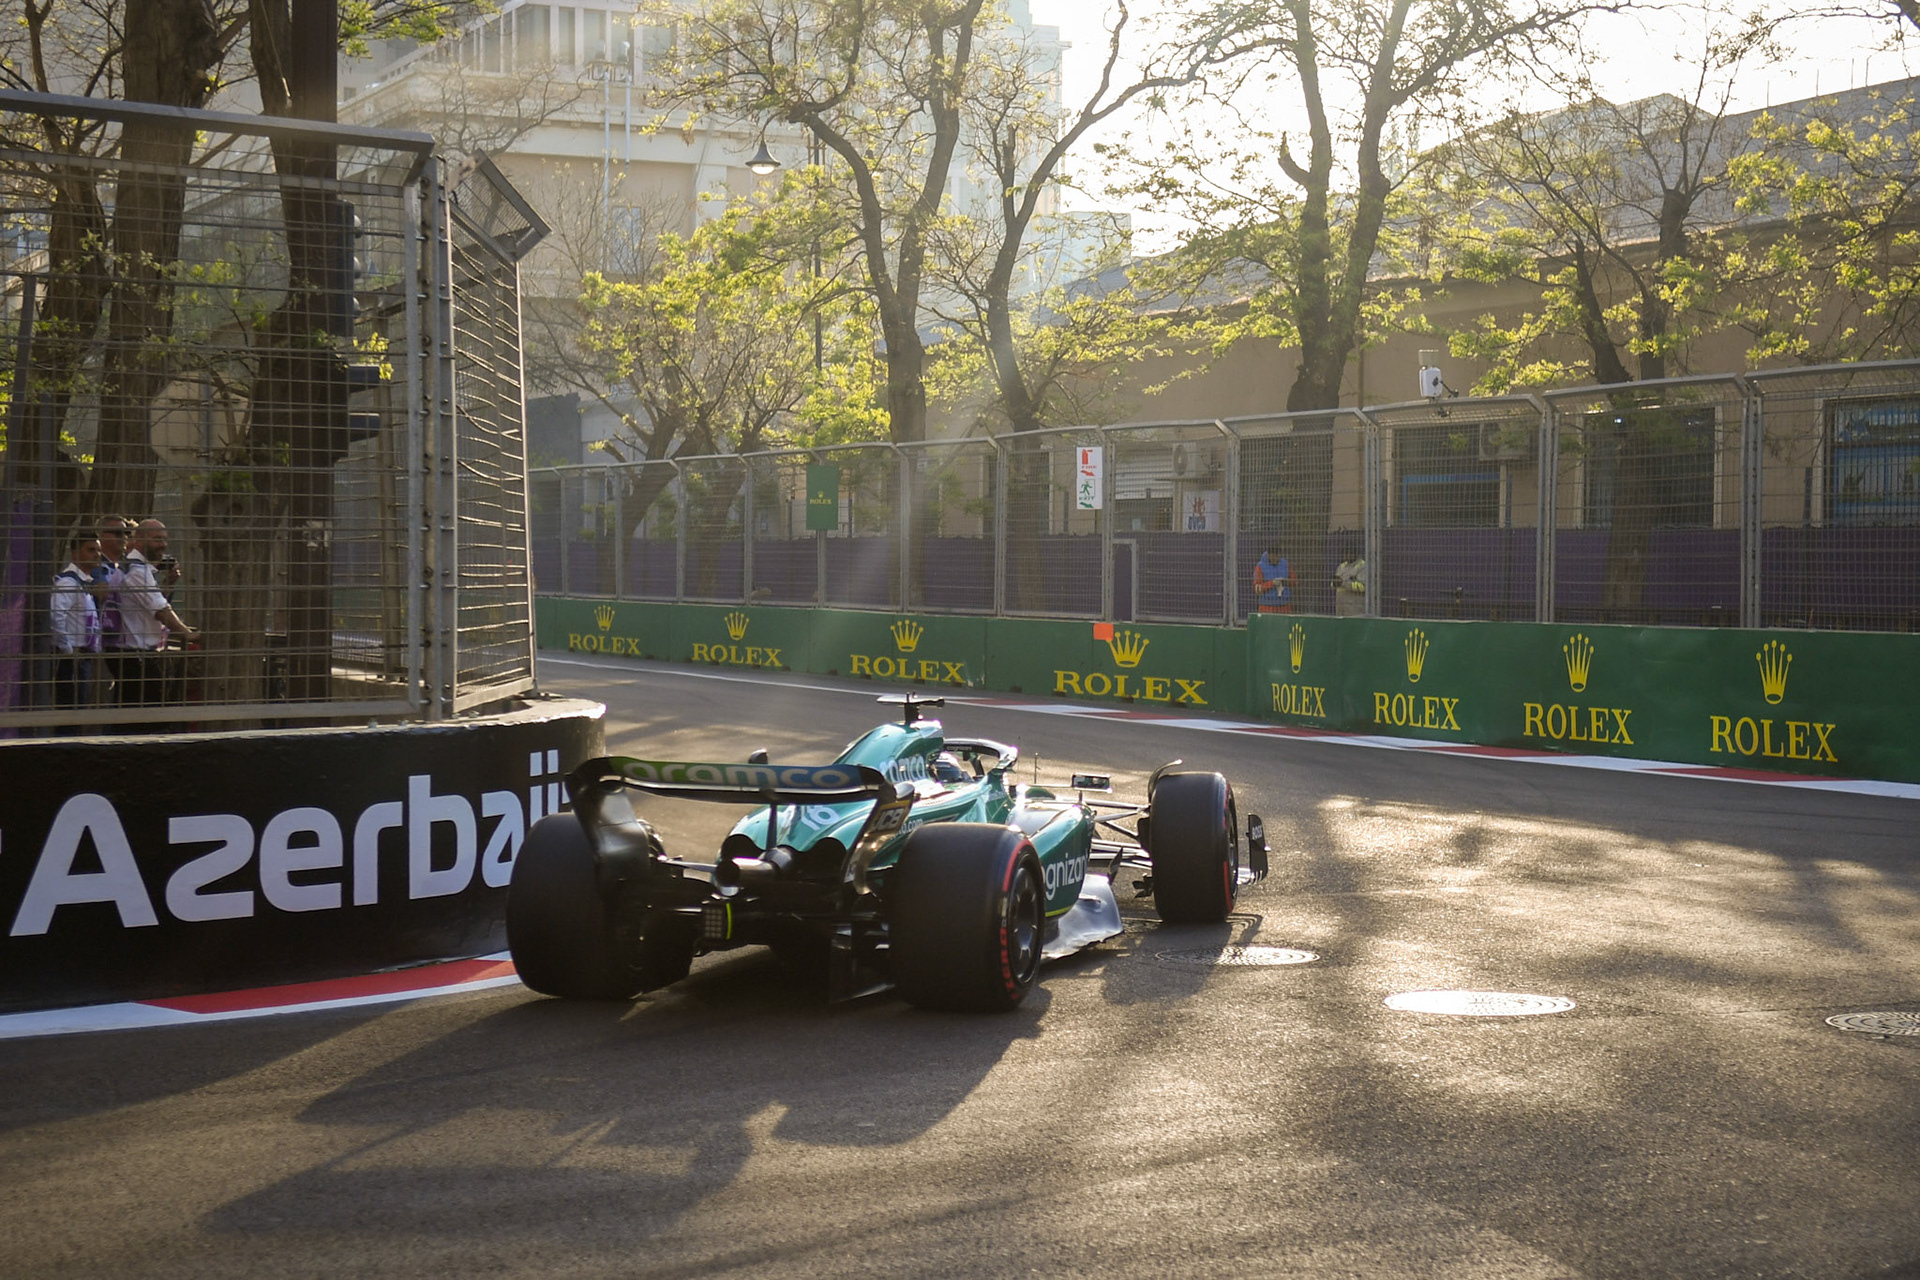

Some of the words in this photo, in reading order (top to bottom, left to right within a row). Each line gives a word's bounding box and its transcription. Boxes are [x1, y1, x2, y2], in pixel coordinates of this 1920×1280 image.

[569, 633, 641, 655] ROLEX
[692, 643, 783, 667] ROLEX
[850, 654, 966, 684] ROLEX
[1055, 670, 1208, 704] ROLEX
[1272, 682, 1326, 718] ROLEX
[1374, 692, 1461, 731] ROLEX
[1523, 703, 1635, 745] ROLEX
[1709, 715, 1838, 762] ROLEX
[623, 762, 850, 788] aramco
